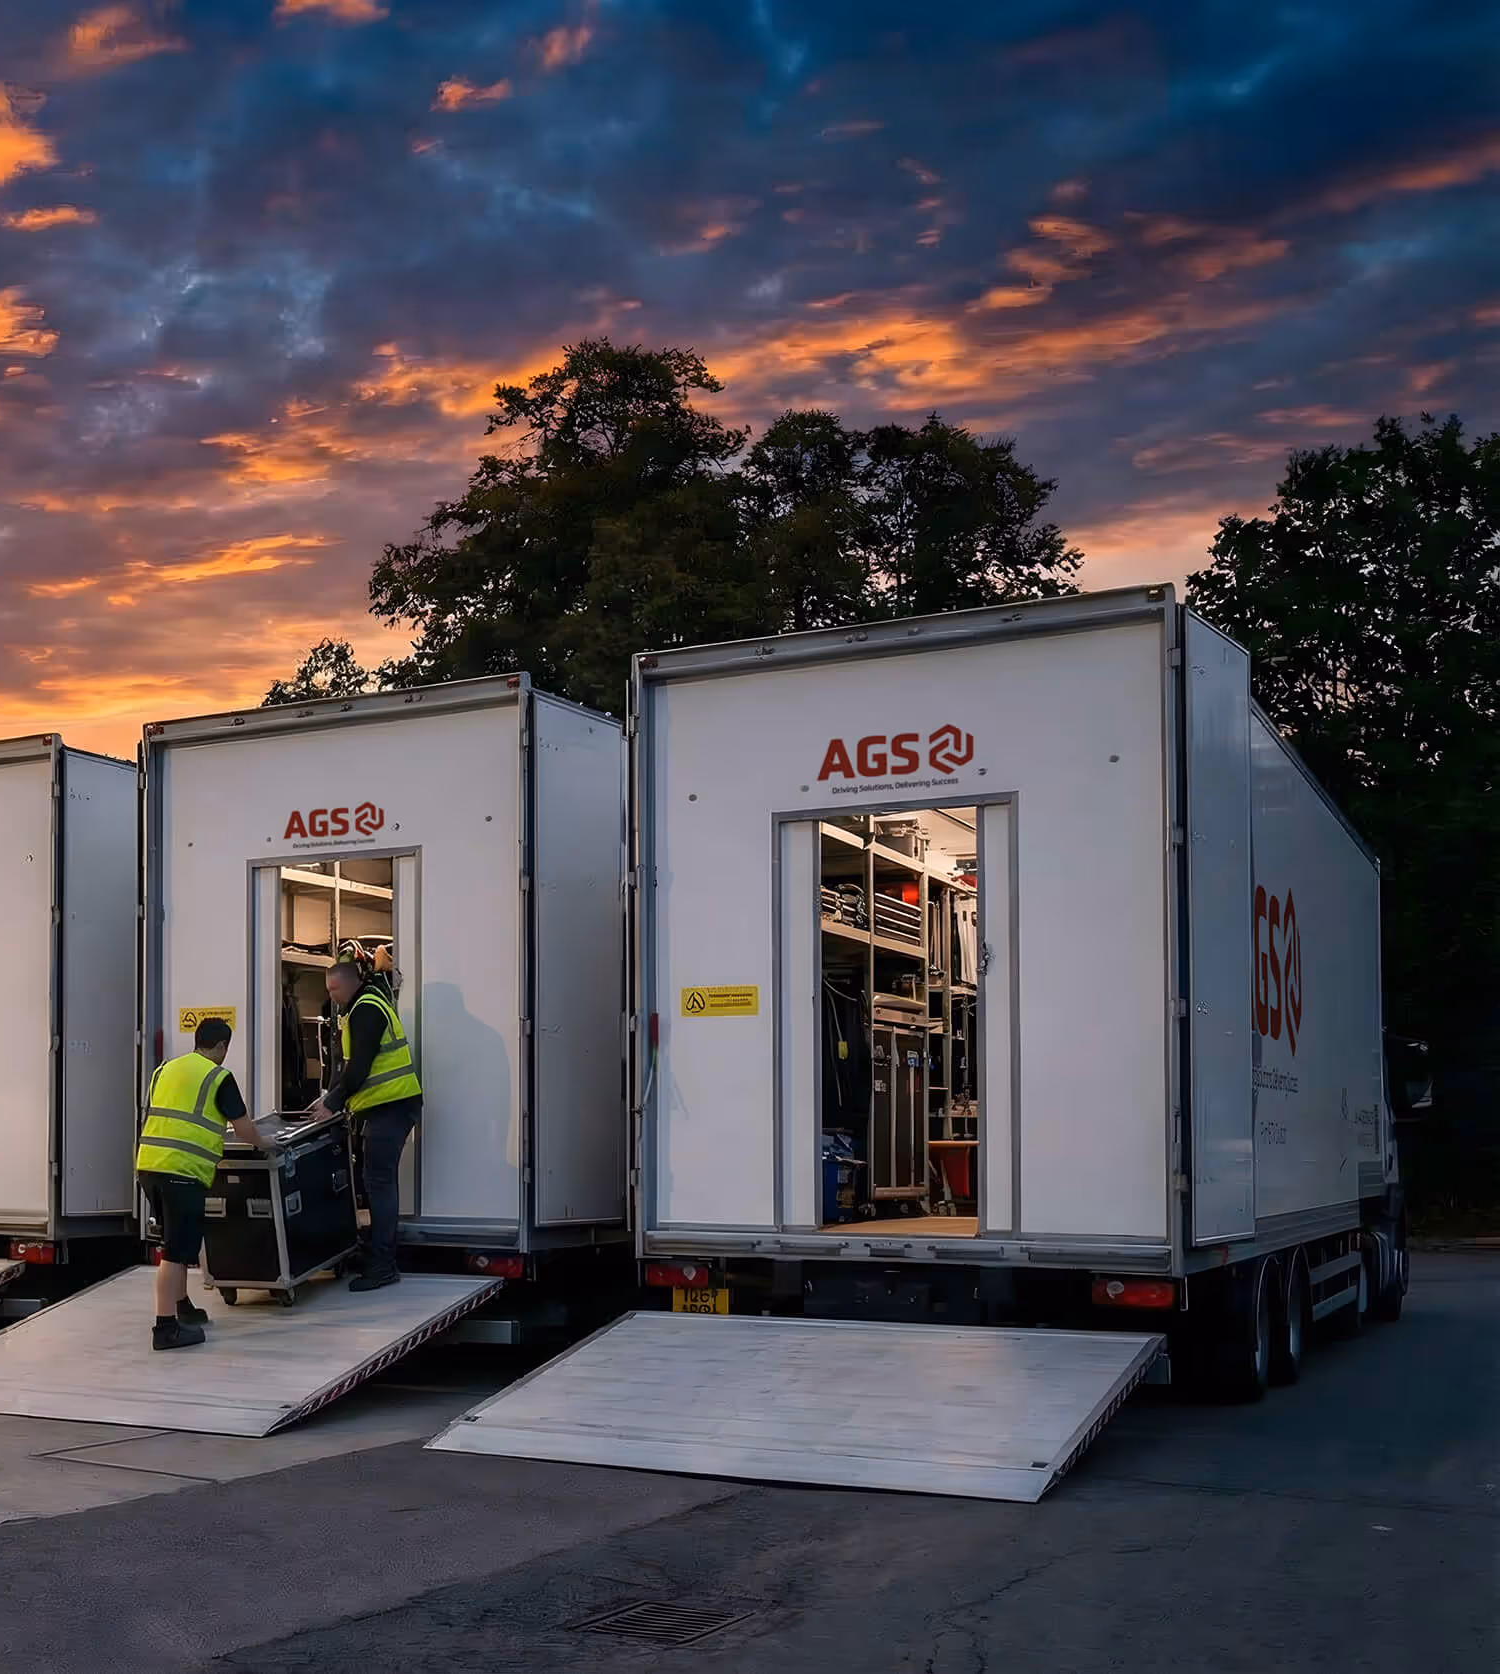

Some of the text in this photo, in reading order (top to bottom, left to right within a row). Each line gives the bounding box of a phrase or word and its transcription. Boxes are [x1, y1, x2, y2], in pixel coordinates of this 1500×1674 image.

[817, 732, 920, 781] AGS
[832, 785, 858, 794] Driving
[895, 779, 931, 789] Delivering
[931, 777, 959, 786] Success
[283, 807, 349, 840] AGS
[1251, 884, 1283, 1041] GS
